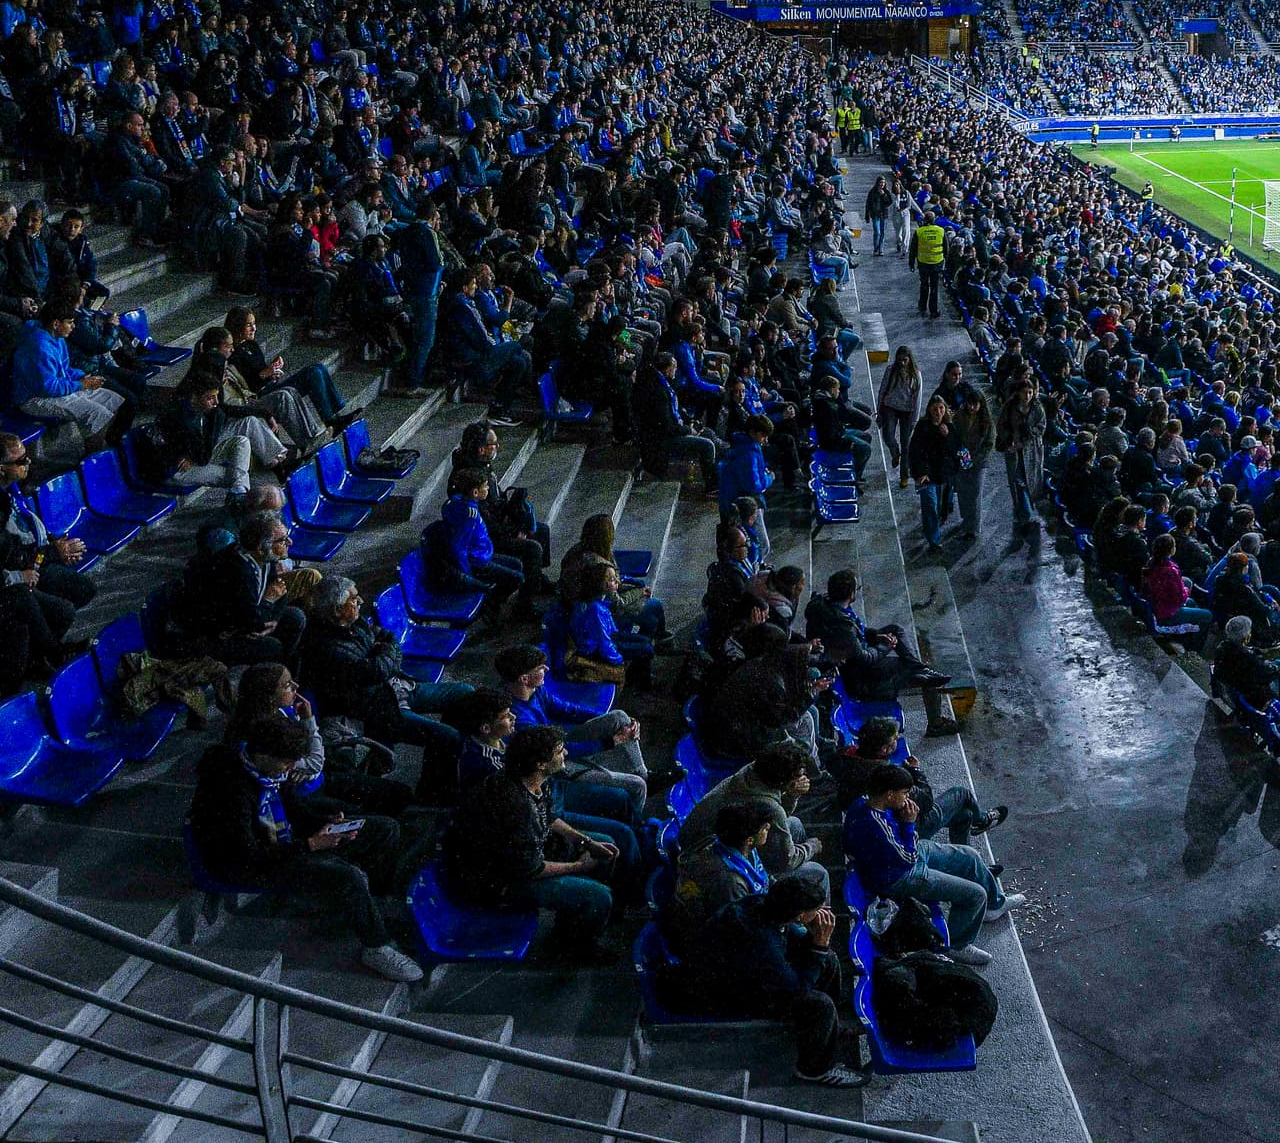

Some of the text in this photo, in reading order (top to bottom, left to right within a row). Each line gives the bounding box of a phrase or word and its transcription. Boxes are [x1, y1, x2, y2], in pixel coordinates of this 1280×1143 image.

[781, 6, 928, 20] Silken MONUMENTAL NARANCO
